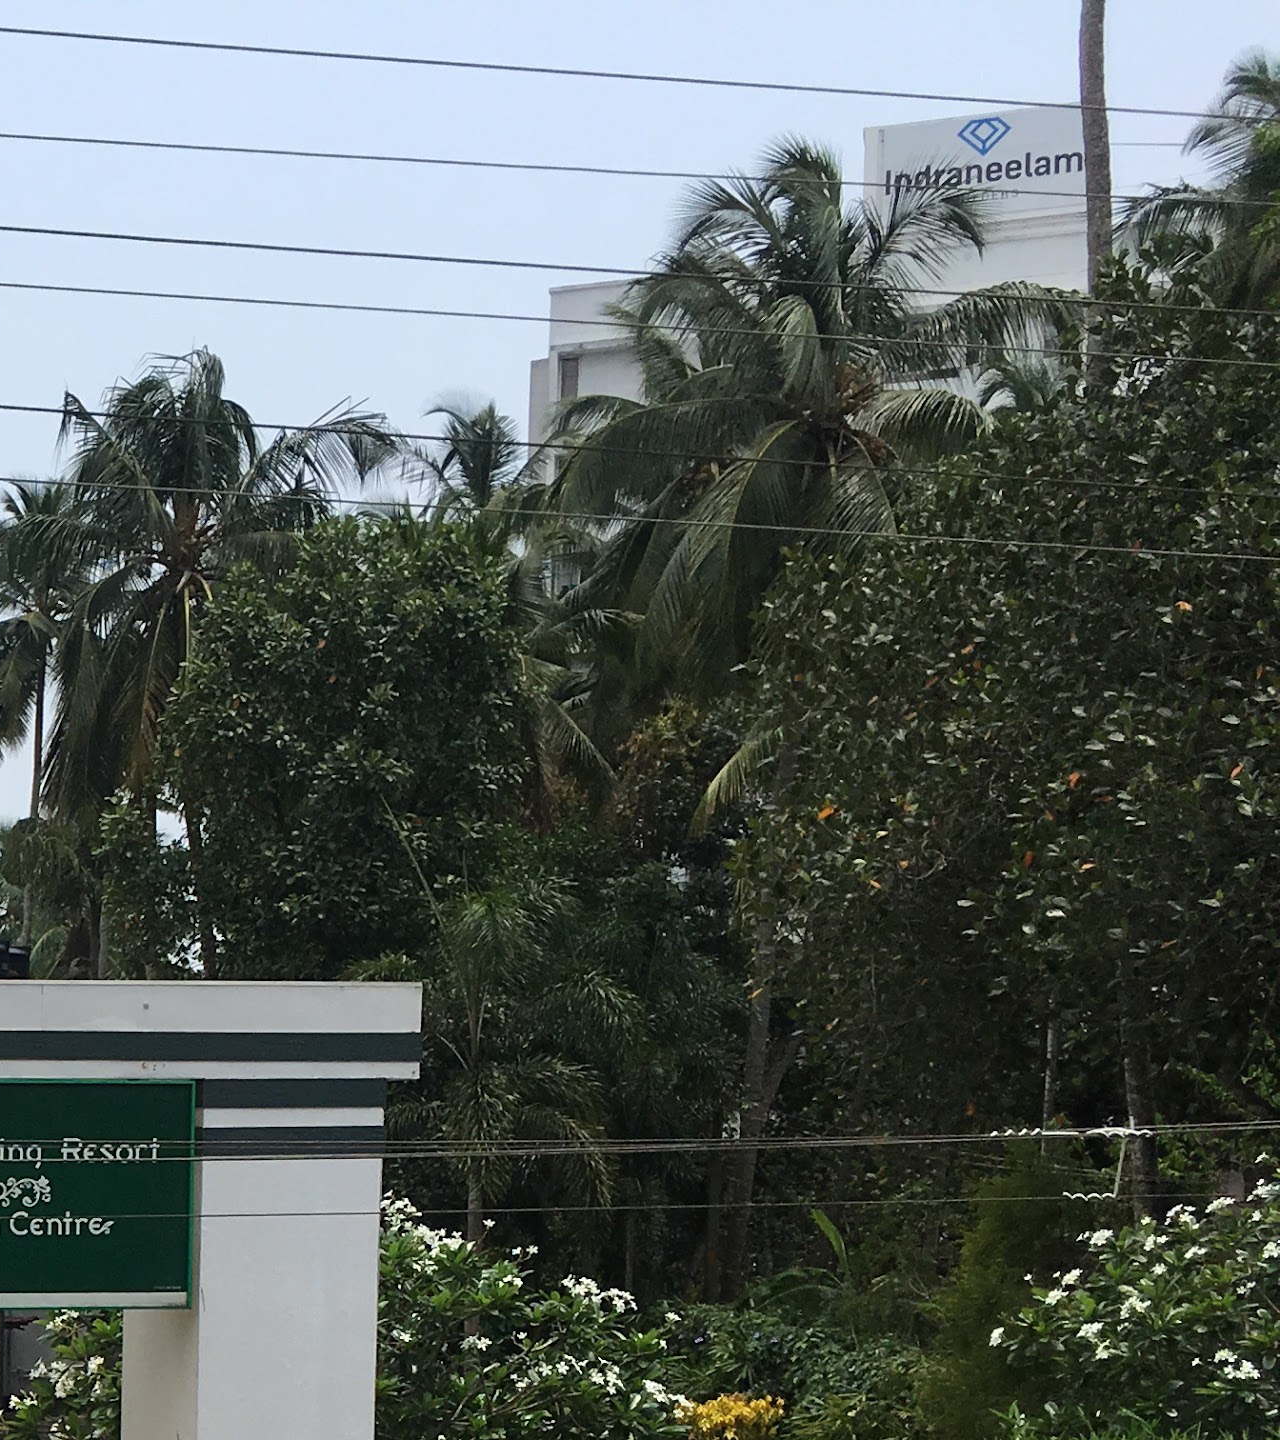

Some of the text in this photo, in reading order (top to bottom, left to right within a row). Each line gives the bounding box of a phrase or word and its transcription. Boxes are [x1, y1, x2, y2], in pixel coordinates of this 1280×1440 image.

[884, 152, 1083, 195] Indraneelam
[61, 1137, 160, 1164] Resort
[10, 1210, 114, 1236] Centre
